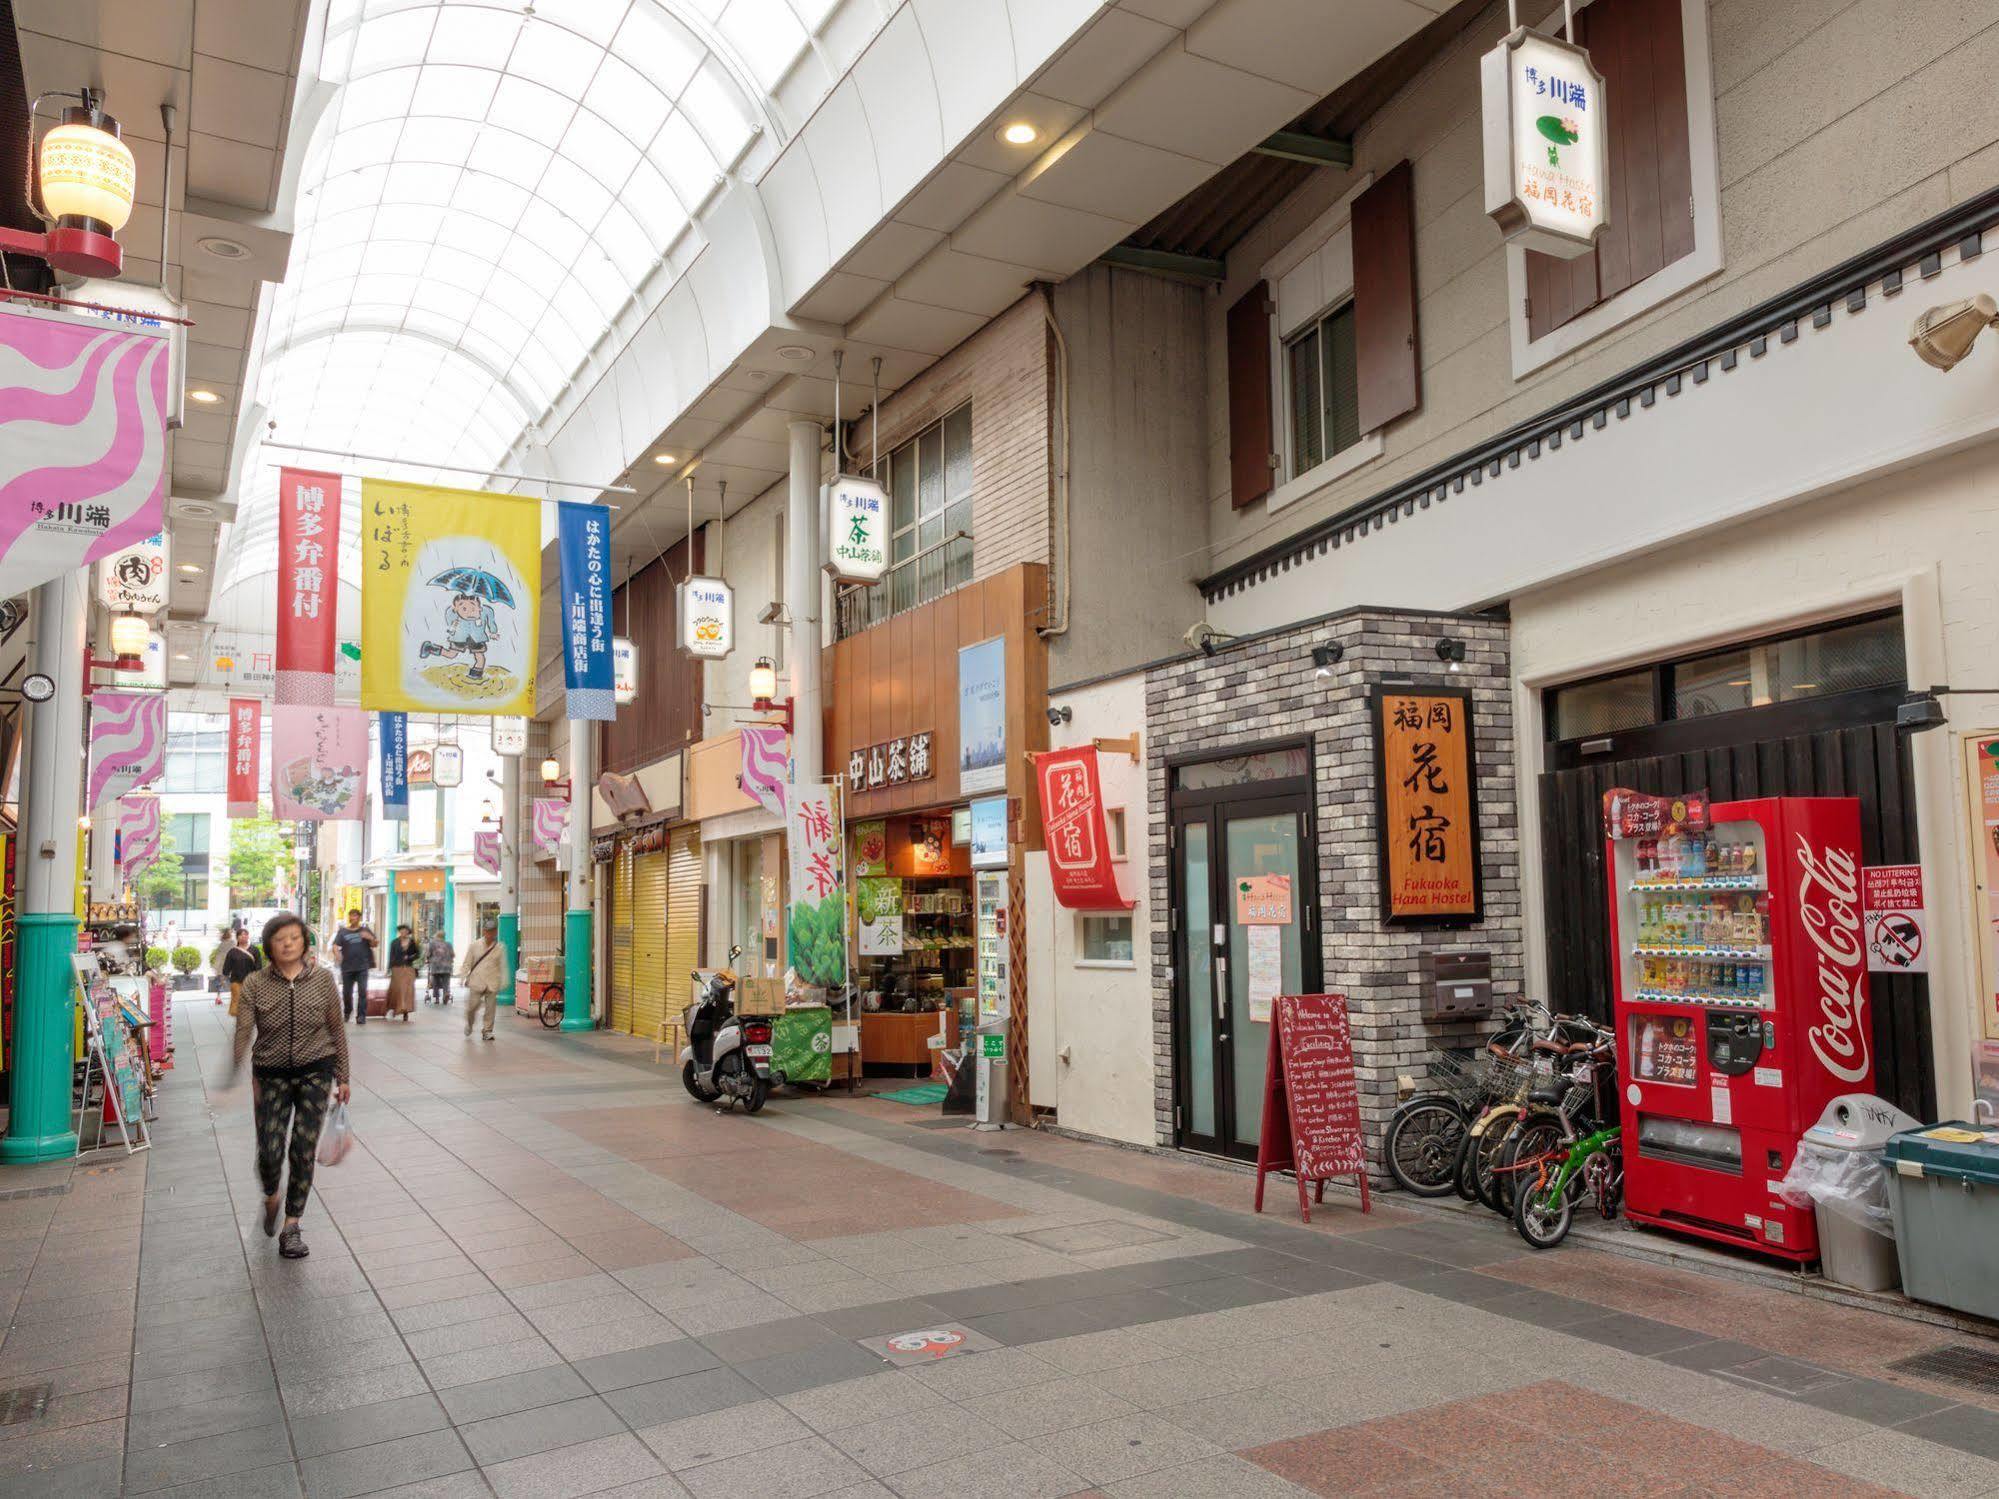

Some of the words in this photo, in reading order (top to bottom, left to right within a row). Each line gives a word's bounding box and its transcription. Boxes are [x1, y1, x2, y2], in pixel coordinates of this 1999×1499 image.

[1525, 65, 1586, 112] 博多川端
[1524, 180, 1592, 218] 福岡花宿
[31, 501, 110, 528] 博多川端
[848, 514, 871, 545] 茶
[293, 485, 325, 619] 博多弁番付
[1394, 701, 1451, 734] 福岡
[849, 734, 928, 790] 中山茶舗
[1403, 743, 1451, 864] 花宿
[1404, 877, 1459, 890] Fukuoka
[1870, 871, 1881, 879] NO
[1882, 869, 1918, 878] LITTERING
[1392, 892, 1427, 904] Hana
[1431, 891, 1472, 904] Hostel
[1796, 832, 1869, 1083] Coca-Cola
[1298, 1008, 1320, 1019] Welcome
[1657, 1054, 1696, 1066] コカ・コーラ
